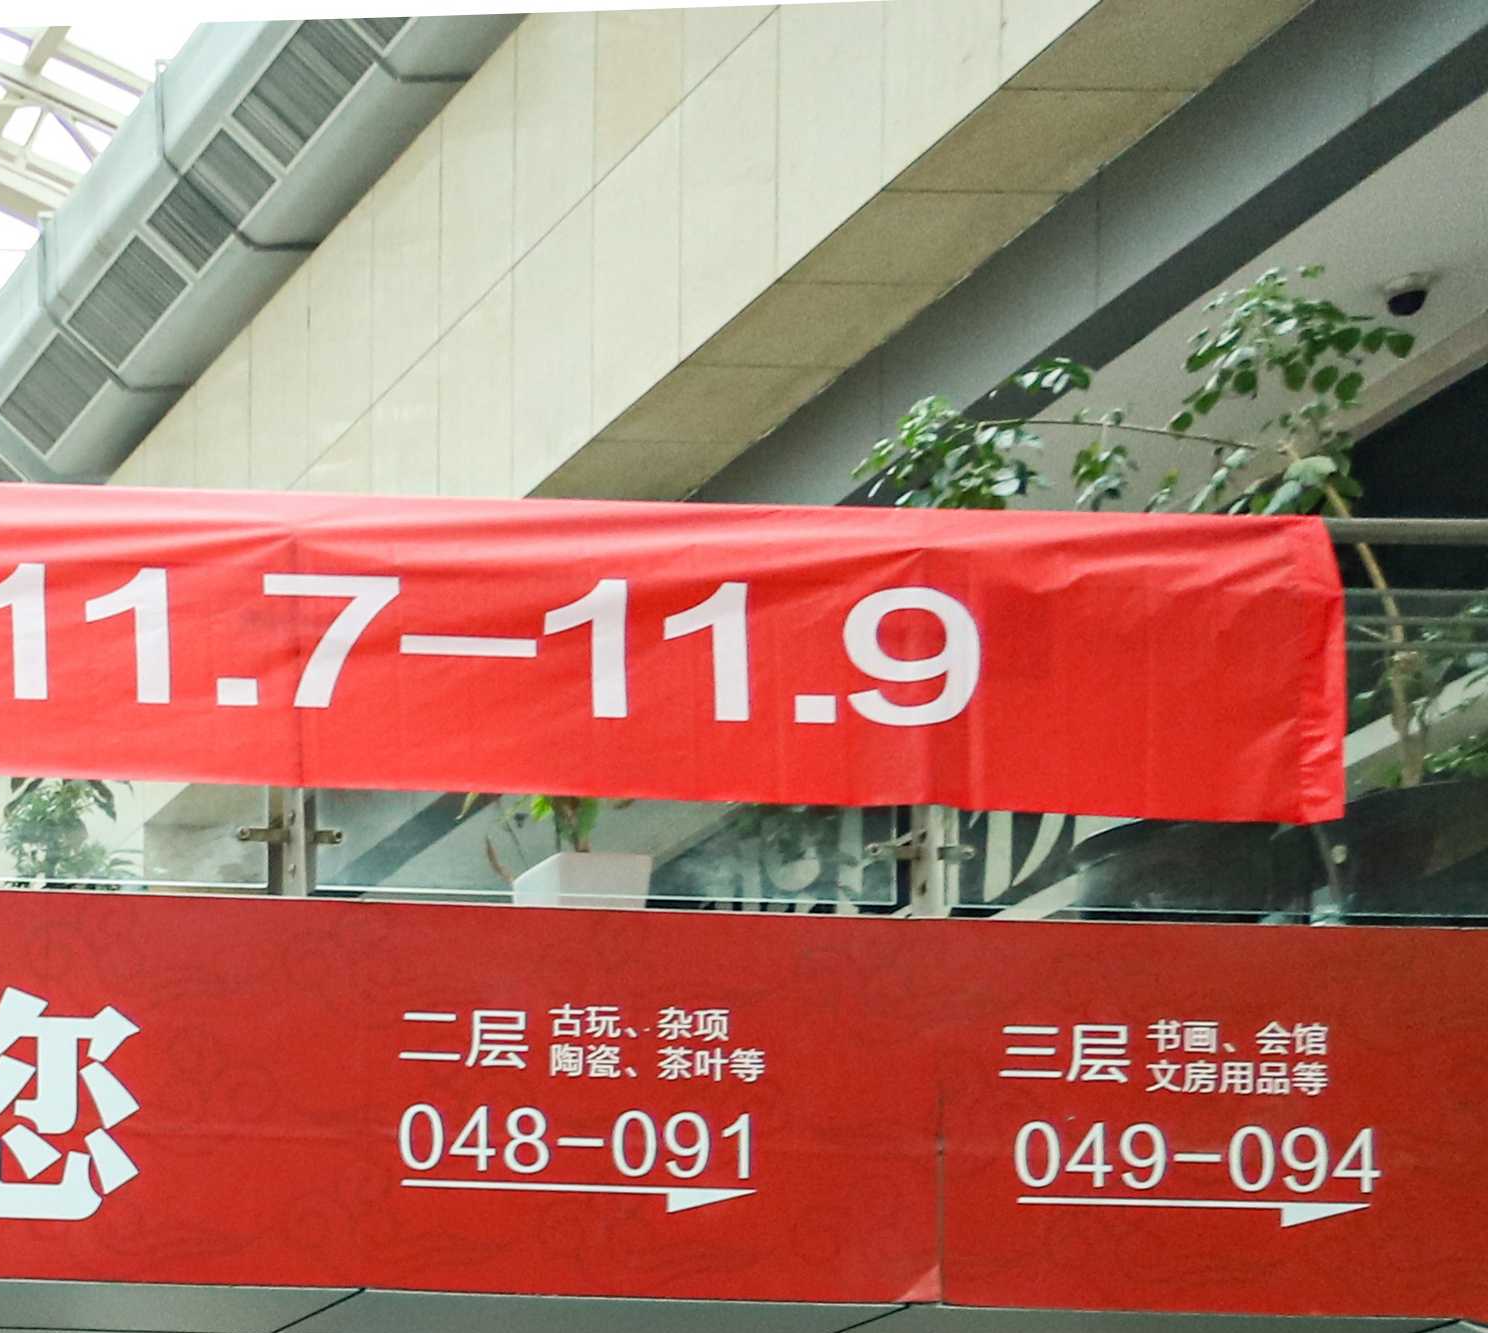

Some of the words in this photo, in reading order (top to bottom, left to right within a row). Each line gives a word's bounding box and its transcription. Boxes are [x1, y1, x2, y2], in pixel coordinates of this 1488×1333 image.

[399, 1010, 529, 1069] 二层
[549, 1004, 730, 1043] 古玩、杂项
[1147, 1019, 1328, 1056] 书画、会馆
[549, 1043, 766, 1083] 陶瓷、茶叶等
[999, 1024, 1130, 1083] 三层
[1146, 1058, 1328, 1096] 文房用品等
[399, 1103, 755, 1179] 048-091
[1015, 1121, 1381, 1195] 049-094
